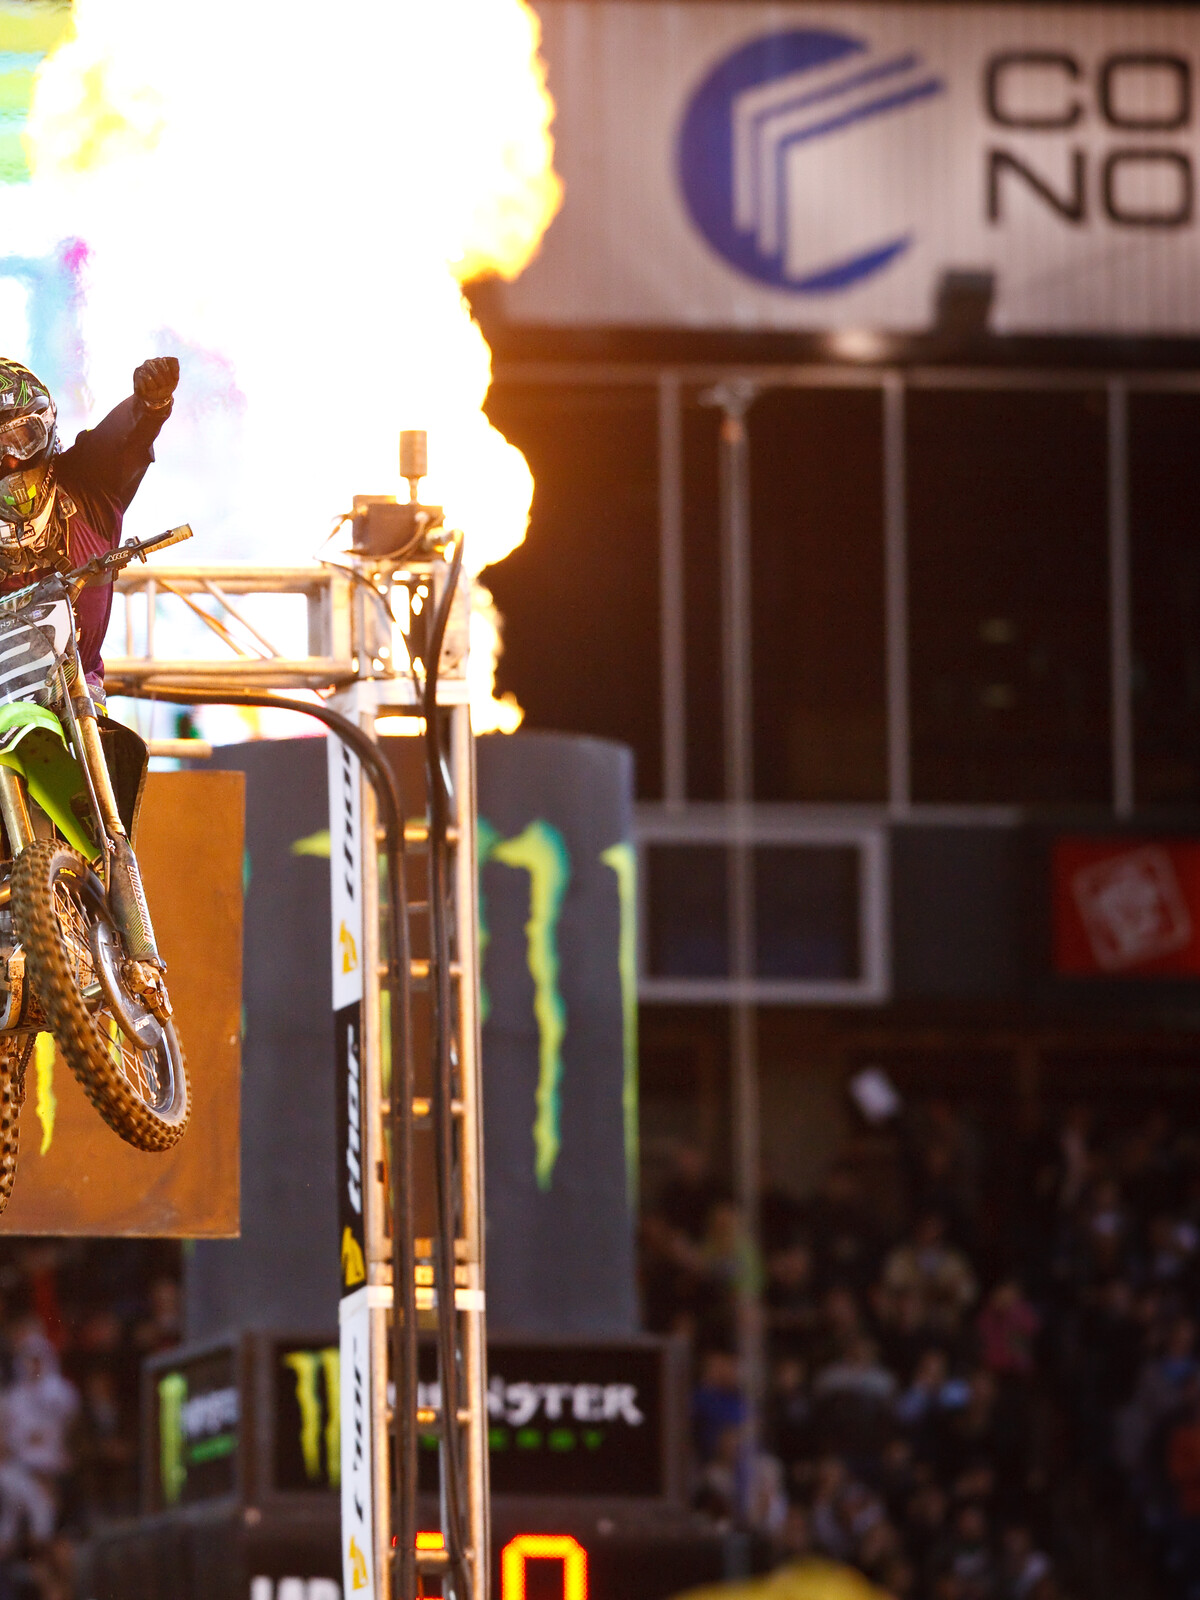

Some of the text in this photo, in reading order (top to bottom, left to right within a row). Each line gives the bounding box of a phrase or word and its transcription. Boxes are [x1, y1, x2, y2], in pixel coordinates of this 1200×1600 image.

[983, 48, 1192, 132] CO
[985, 146, 1195, 229] NO
[104, 549, 129, 564] ARC
